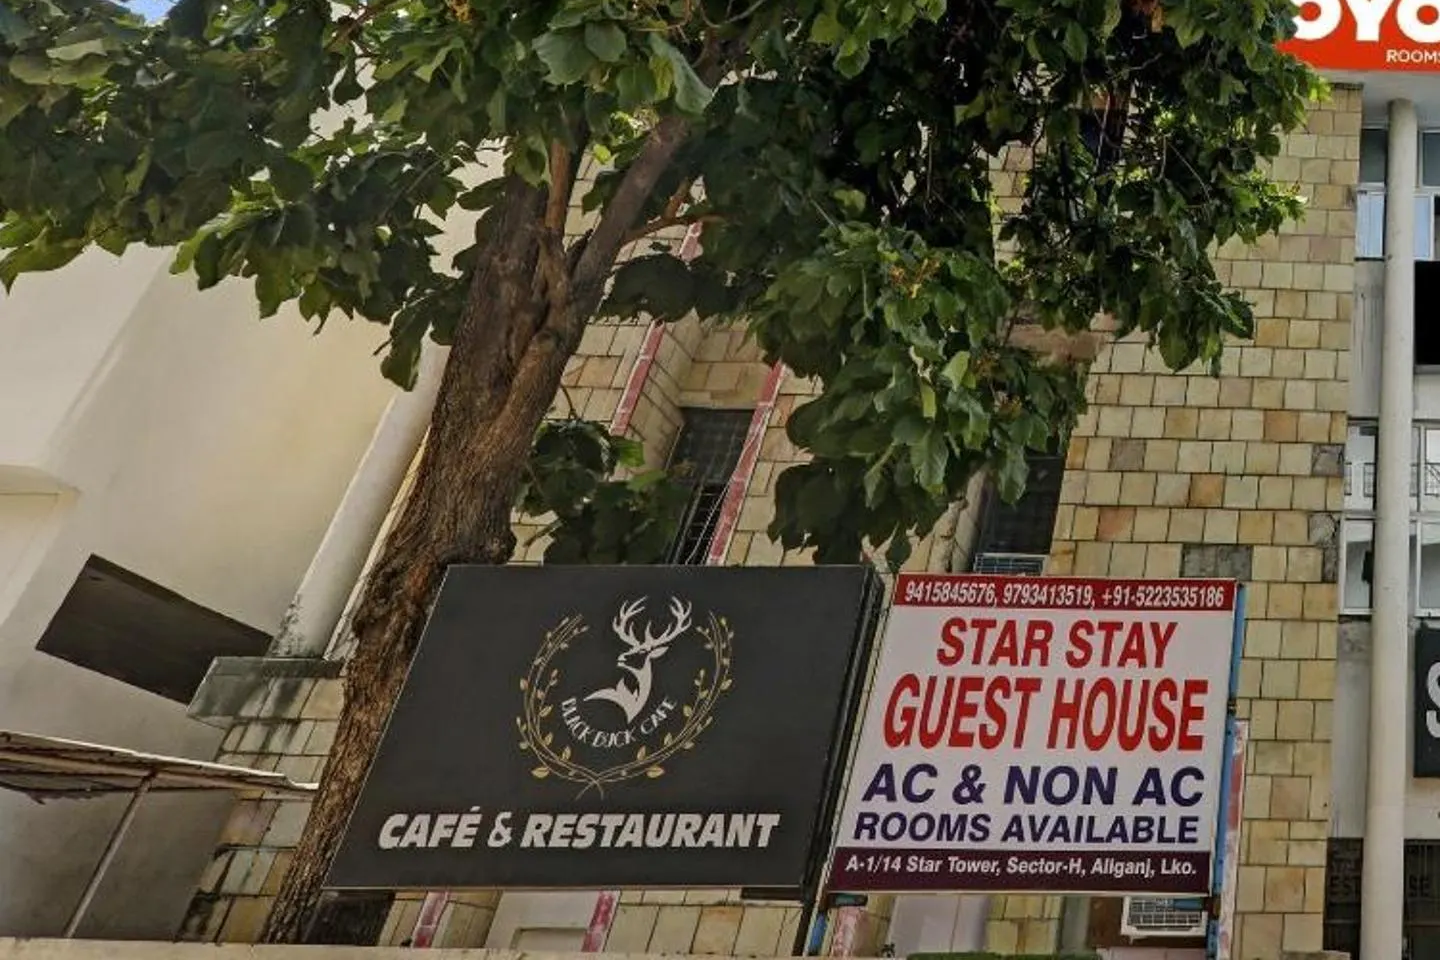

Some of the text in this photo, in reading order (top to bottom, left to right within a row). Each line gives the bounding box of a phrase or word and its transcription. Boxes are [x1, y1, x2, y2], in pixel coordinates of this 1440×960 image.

[904, 581, 1225, 609] 9415845676, 9793413519, +91-5223535186
[936, 617, 1179, 669] STAR STAY
[883, 673, 1209, 752] GUEST HOUSE
[861, 762, 1205, 808] AC & NON AC
[378, 806, 781, 851] CAFÉ & RESTAURANT
[853, 812, 1199, 844] ROOMS AVAILABLE
[845, 855, 901, 873] A-1/14
[906, 856, 941, 873] Star
[948, 856, 1000, 877] Tower,
[1006, 858, 1086, 876] Sector-H,
[1161, 860, 1197, 876] Lko.
